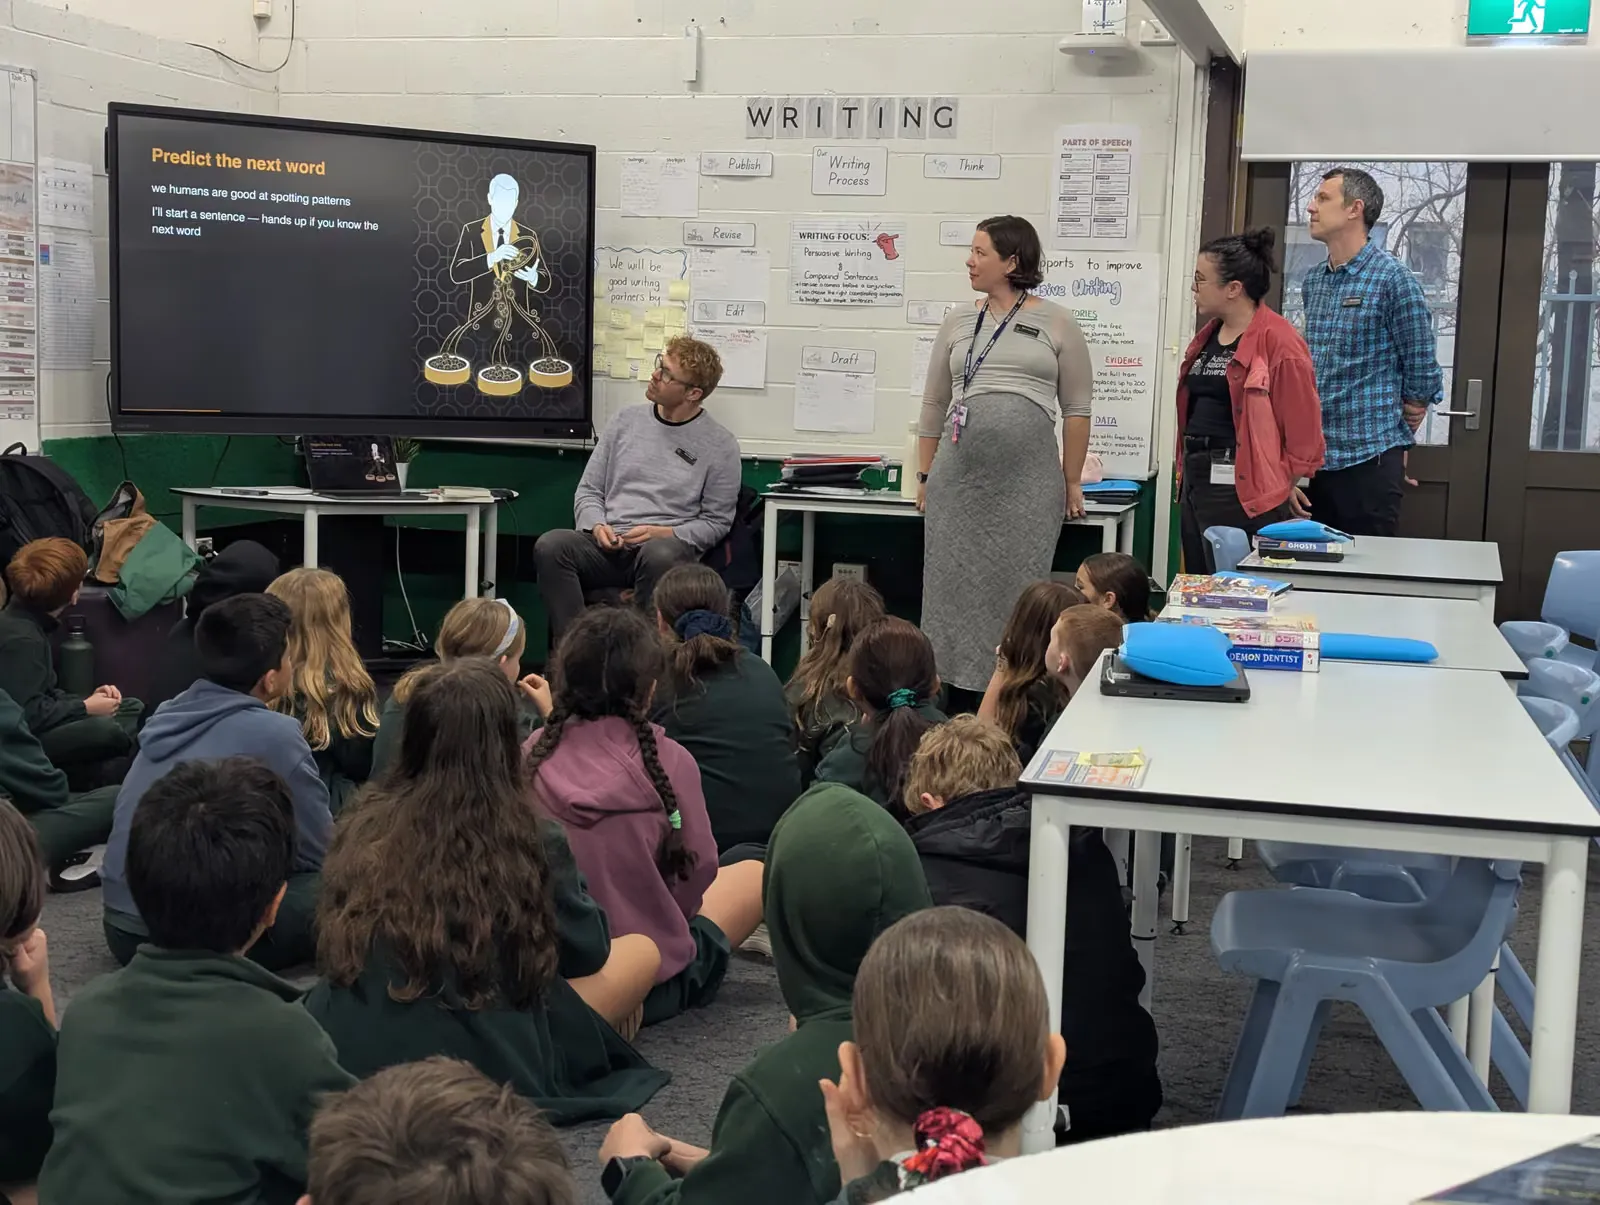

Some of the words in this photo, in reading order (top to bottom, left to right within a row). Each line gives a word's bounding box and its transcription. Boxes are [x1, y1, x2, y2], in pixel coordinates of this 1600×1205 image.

[747, 106, 953, 129] WRITING
[1102, 139, 1132, 147] SPEECH
[151, 148, 211, 167] Predict
[216, 154, 241, 169] the
[247, 157, 281, 172] next
[286, 161, 326, 175] word
[728, 157, 761, 170] Publish
[829, 156, 871, 176] Writing
[959, 158, 985, 171] Think
[828, 172, 870, 186] Process
[151, 184, 167, 194] we
[169, 184, 209, 197] humans
[211, 188, 228, 198] are
[230, 189, 256, 201] good
[258, 191, 268, 200] at
[270, 191, 309, 206] spotting
[312, 195, 351, 207] patterns
[152, 206, 163, 217] I'll
[165, 208, 188, 219] start
[190, 211, 197, 219] a
[200, 211, 245, 222] sentence
[262, 214, 292, 226] hands
[294, 217, 307, 228] up
[309, 216, 316, 226] if
[317, 219, 335, 231] you
[337, 219, 362, 230] know
[364, 221, 379, 231] the
[152, 226, 174, 235] next
[176, 226, 201, 237] word
[712, 226, 742, 239] Revise
[799, 232, 835, 240] WRITING
[837, 232, 870, 241] FOCUS:
[804, 247, 840, 257] Persuasive
[844, 248, 872, 260] Writing
[609, 256, 623, 269] We
[627, 258, 644, 270] will
[649, 260, 661, 272] be
[1038, 256, 1074, 274] pports
[1087, 258, 1100, 270] to
[1106, 260, 1143, 275] improve
[804, 270, 839, 283] Compound
[844, 271, 879, 281] Sentences
[608, 277, 627, 292] good
[631, 276, 660, 292] writing
[1072, 277, 1122, 306] Writing
[610, 292, 645, 304] partners
[649, 292, 661, 307] by
[725, 304, 745, 317] Edit
[1071, 309, 1098, 318] TORIES
[831, 351, 859, 365] Draft
[1105, 356, 1143, 365] EVIDENCE
[1202, 367, 1227, 376] Universi
[1095, 416, 1117, 425] DATA
[1287, 542, 1317, 550] GHOSTS
[1230, 652, 1260, 662] DEMON
[1262, 653, 1300, 664] DENTIST
